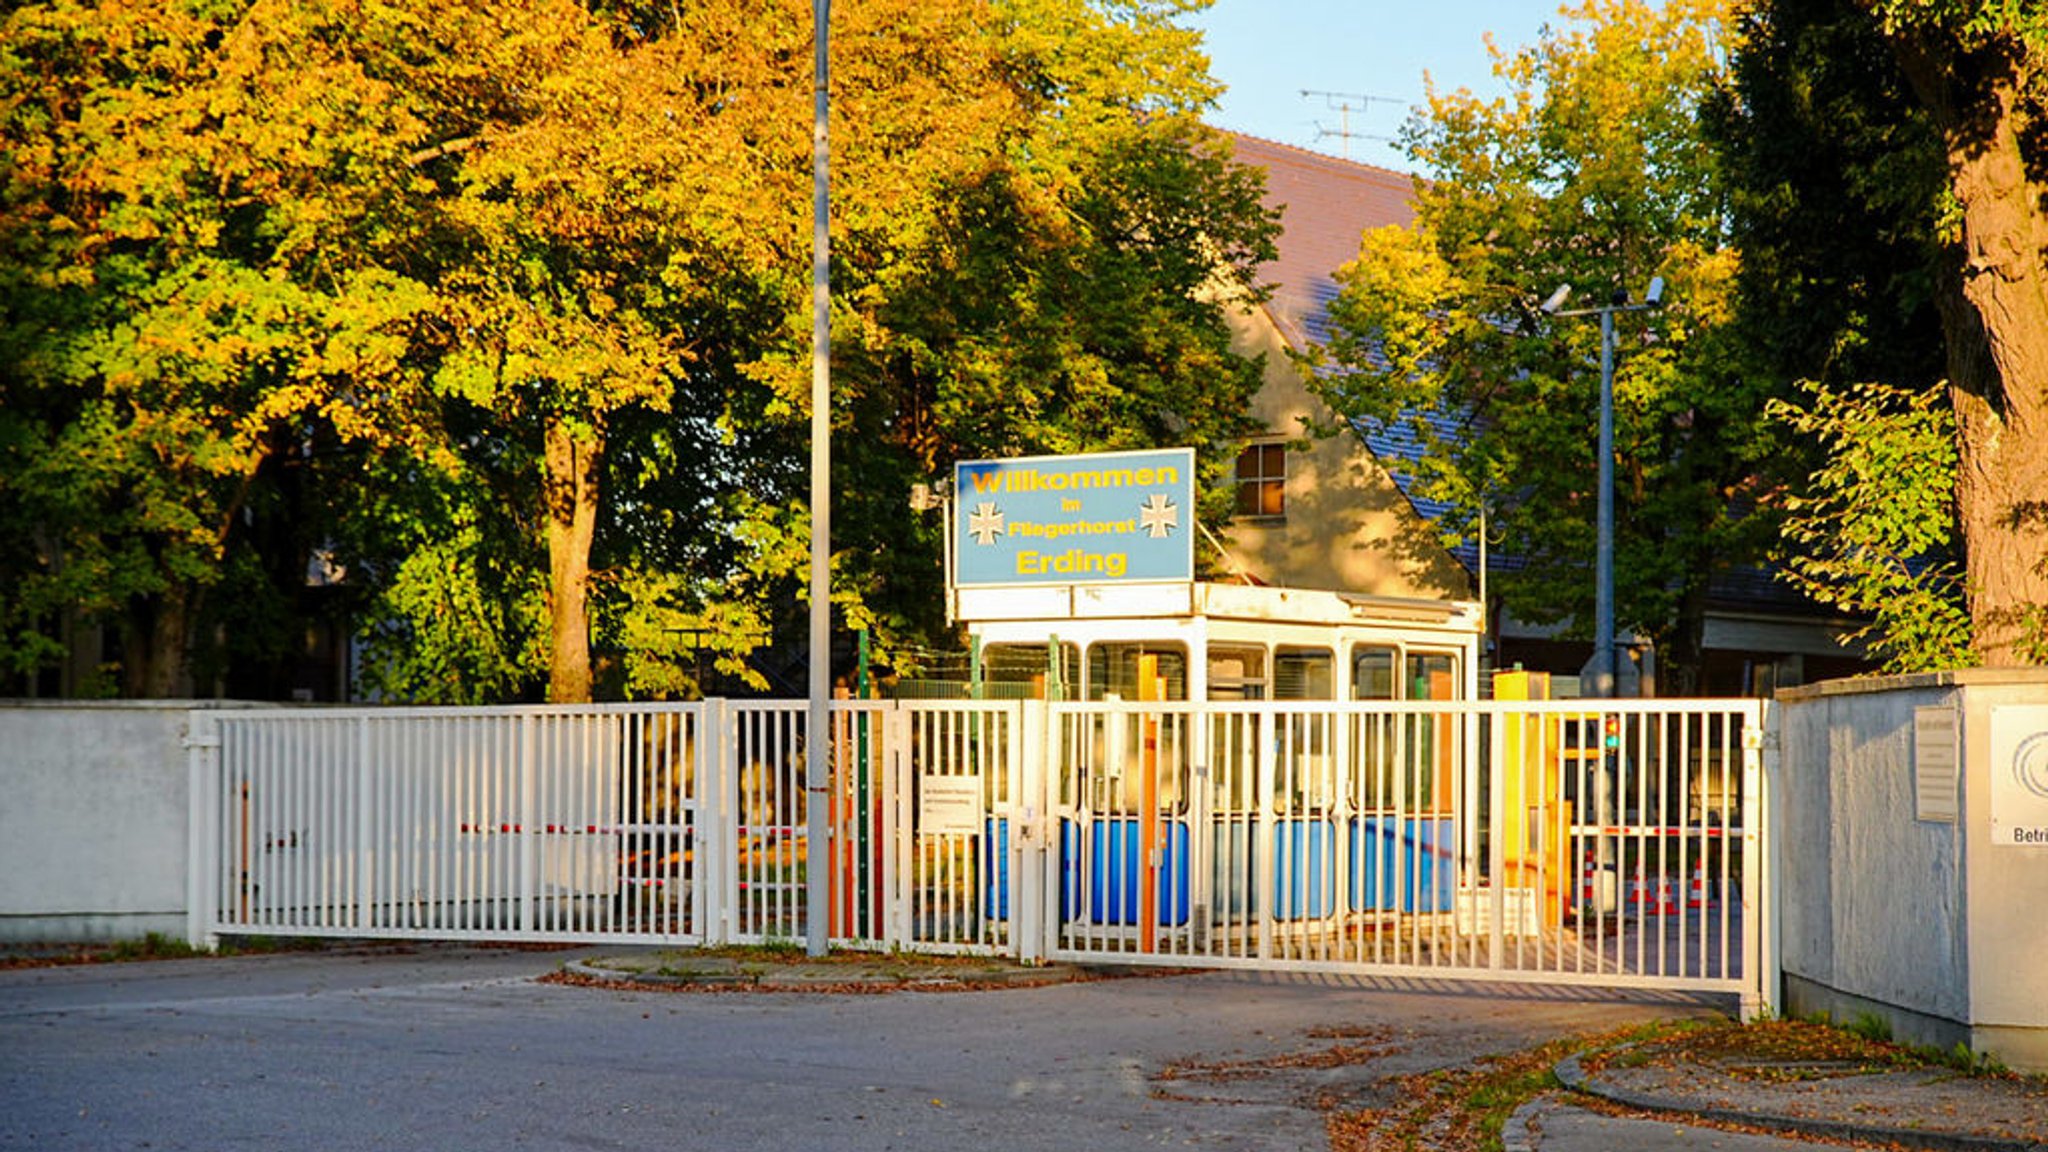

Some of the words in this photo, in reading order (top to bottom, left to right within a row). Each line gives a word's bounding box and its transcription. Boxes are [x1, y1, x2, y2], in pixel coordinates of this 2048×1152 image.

[970, 466, 1179, 494] Willkommen
[1007, 519, 1136, 539] Fliegerhorst
[1016, 548, 1128, 577] Erding
